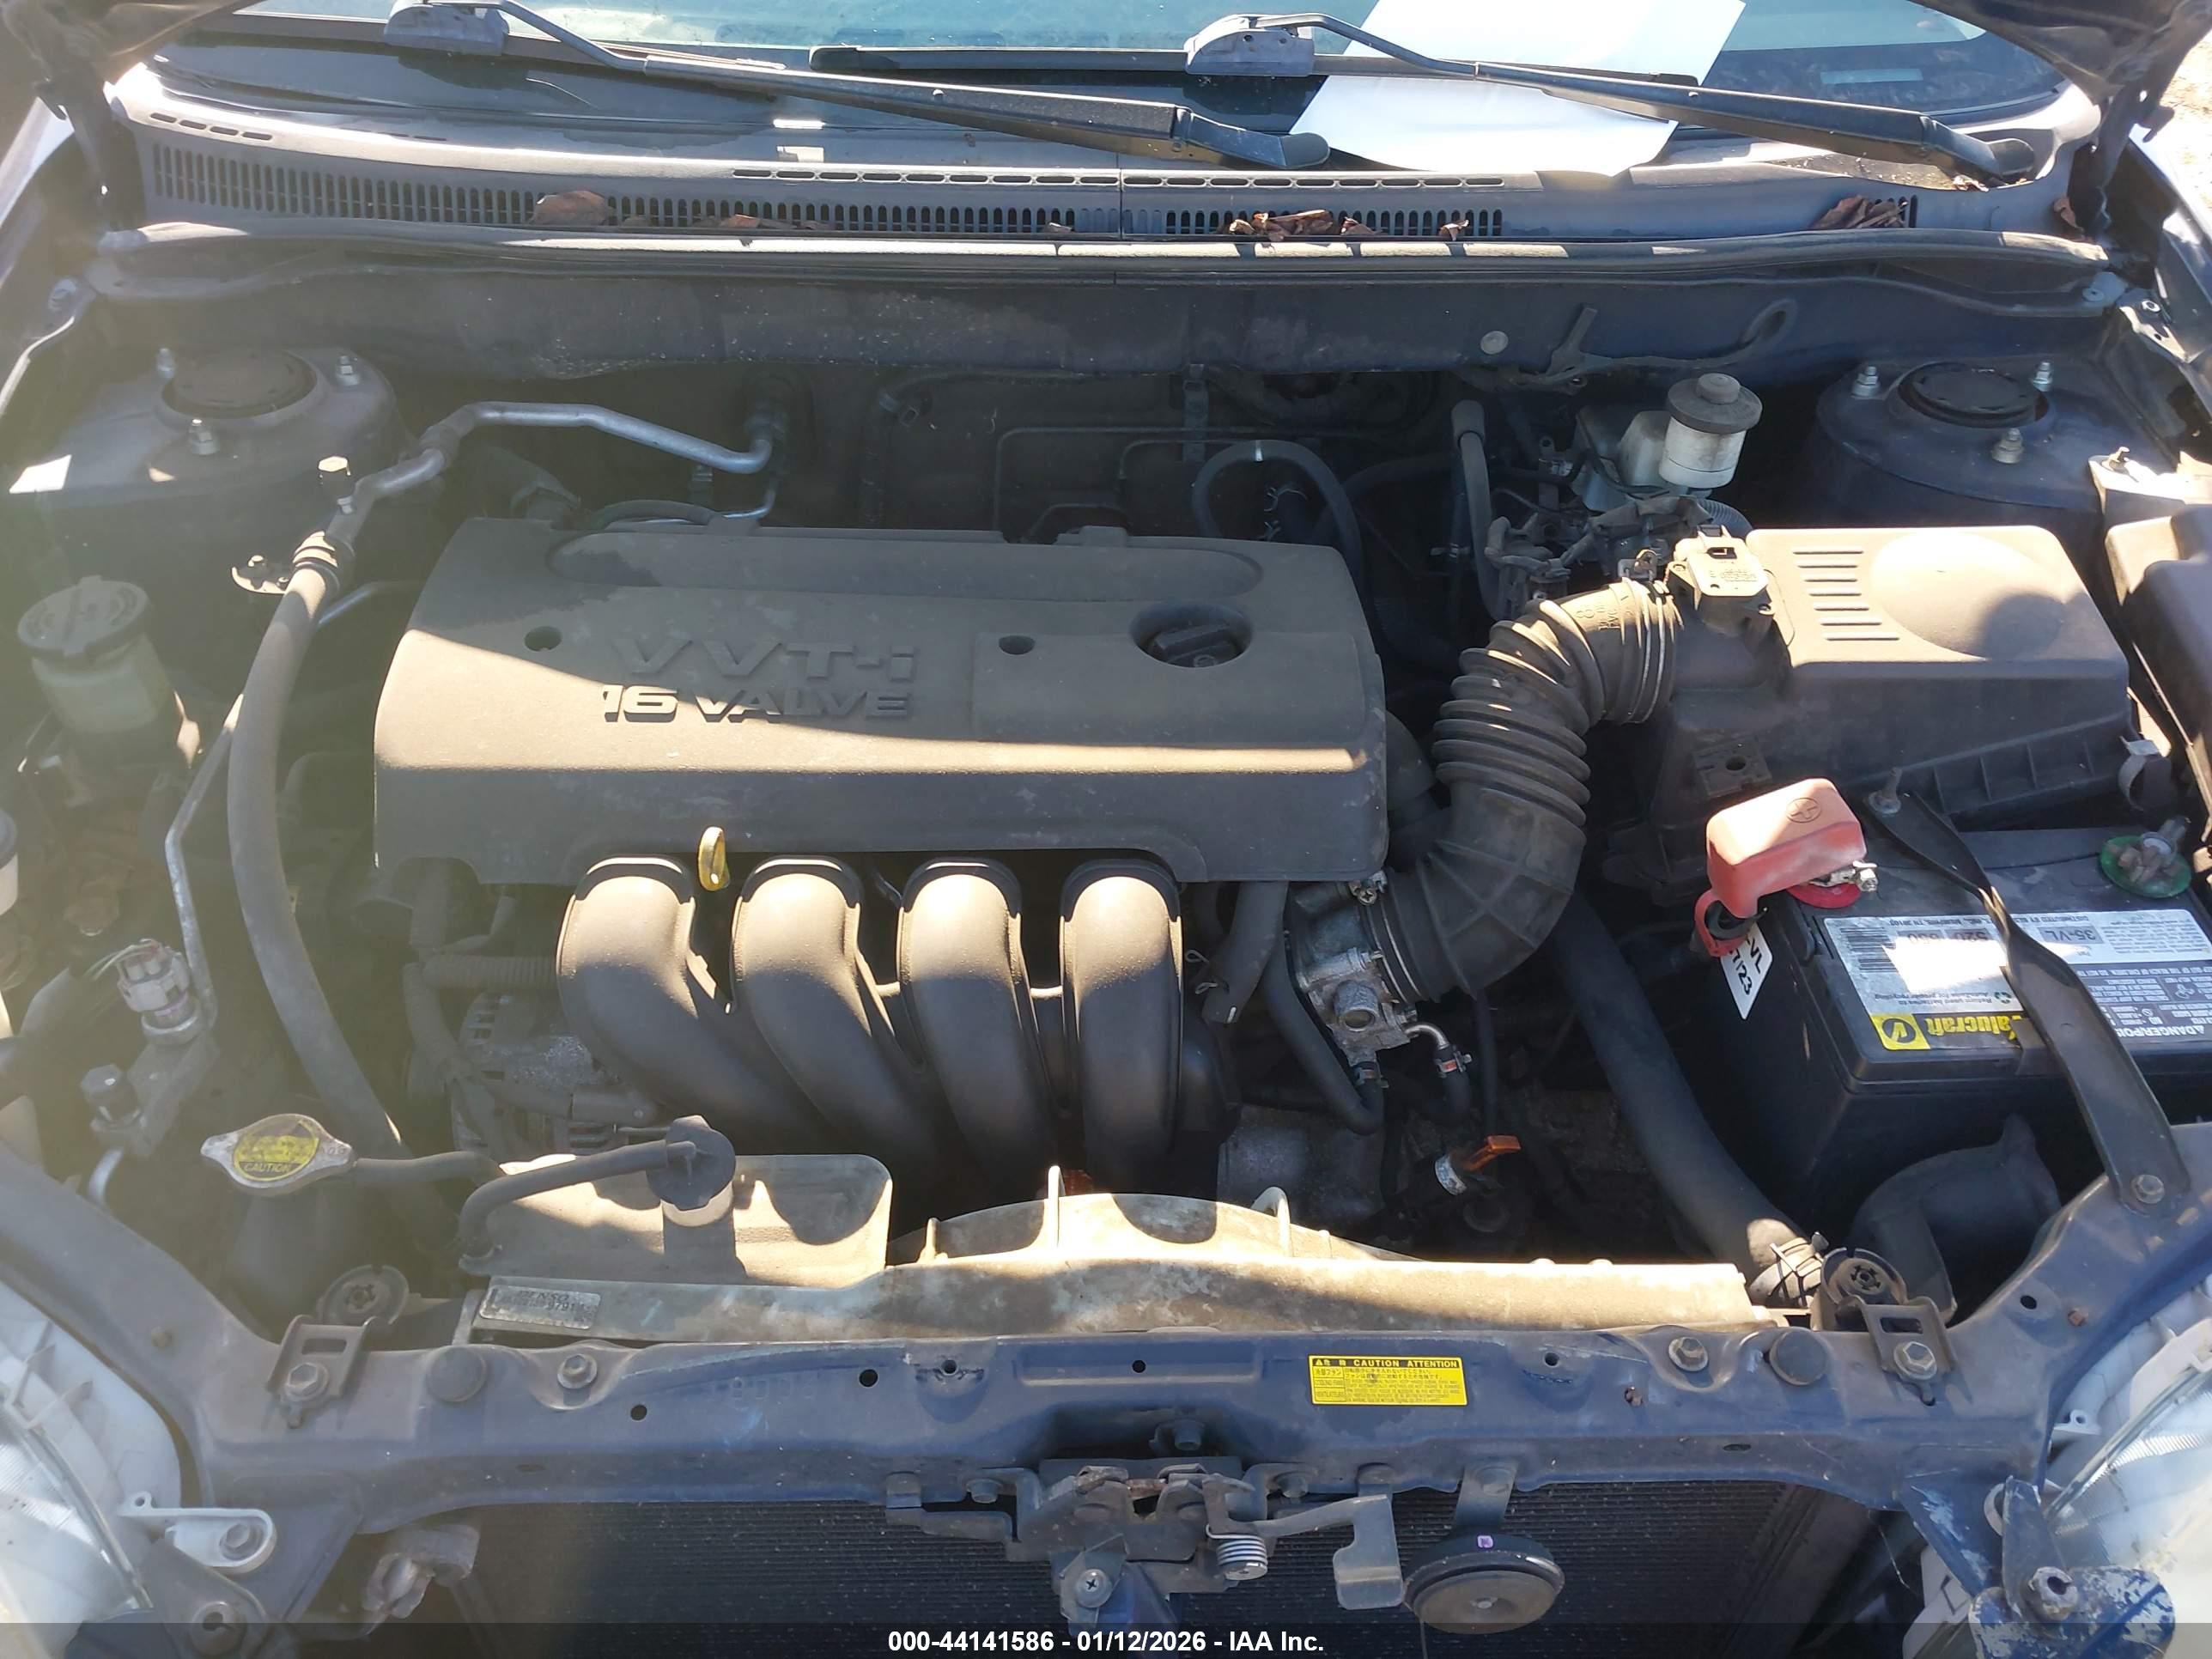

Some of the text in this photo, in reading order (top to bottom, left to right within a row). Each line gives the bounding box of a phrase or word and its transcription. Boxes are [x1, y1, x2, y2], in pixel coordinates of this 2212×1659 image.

[603, 684, 912, 723] 16 VALVE
[2045, 928, 2096, 941] 35-VL
[1746, 936, 1762, 975] -VL
[244, 1163, 292, 1173] CAUTION
[1407, 1359, 1458, 1368] ATTENTION
